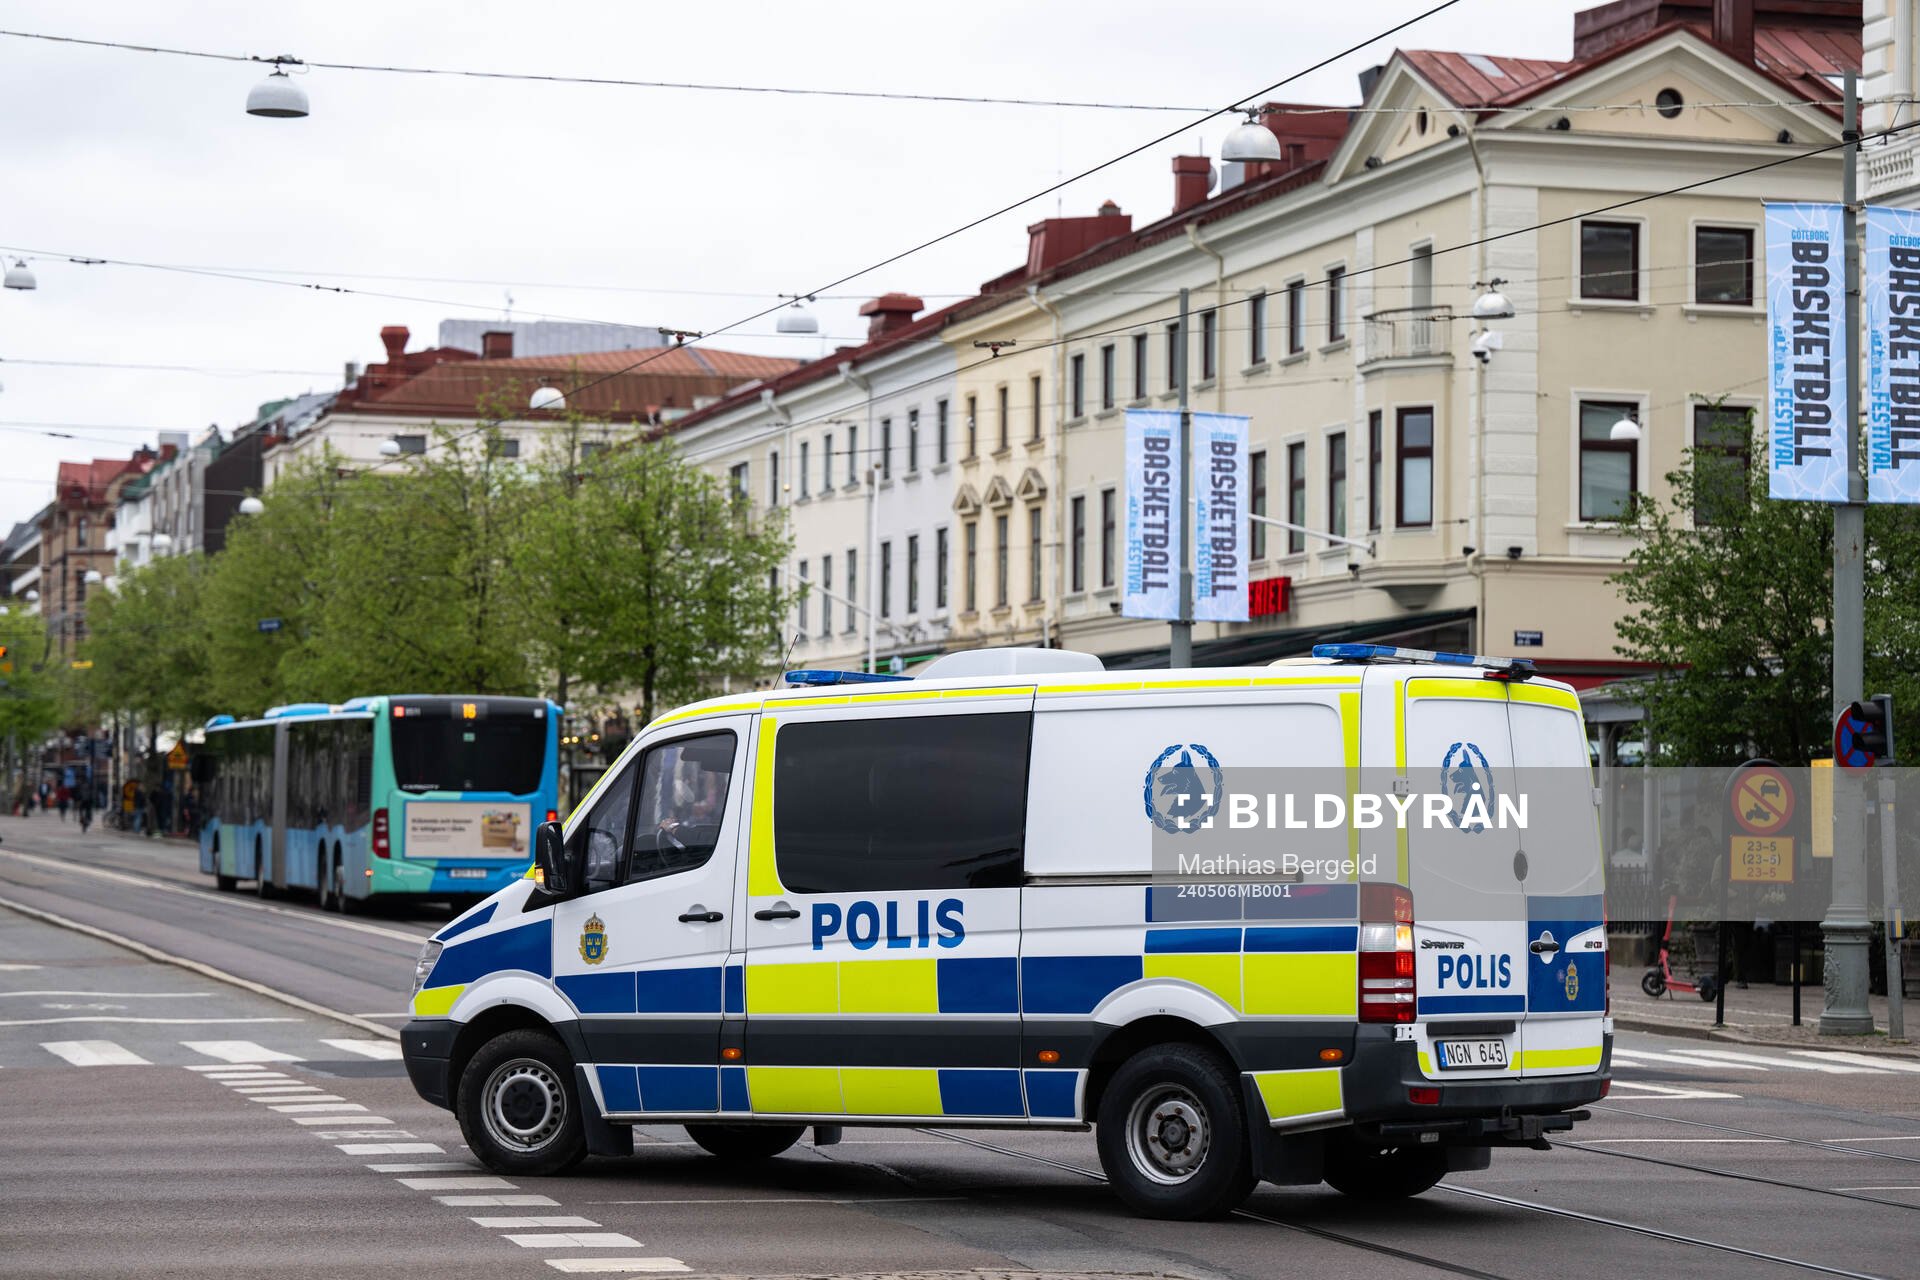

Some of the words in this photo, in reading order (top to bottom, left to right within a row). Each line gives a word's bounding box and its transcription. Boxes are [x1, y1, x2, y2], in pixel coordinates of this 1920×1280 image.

[1791, 228, 1829, 241] GÖTEBORG
[1791, 242, 1832, 466] BASKETBALL
[1889, 247, 1920, 470] BASKETBALL
[1775, 388, 1794, 470] FESTIVAL
[1871, 392, 1893, 474] FESTIVAL
[1142, 437, 1170, 594] BASKETBALL
[1211, 441, 1237, 597] BASKETBALL
[1128, 539, 1143, 597] FESTIVAL
[1197, 543, 1211, 600] FESTIVAL
[1746, 841, 1777, 851] 23-5
[812, 898, 966, 951] POLIS
[1437, 953, 1511, 990] POLIS
[1446, 1043, 1473, 1065] NGN
[1479, 1043, 1504, 1064] 645
